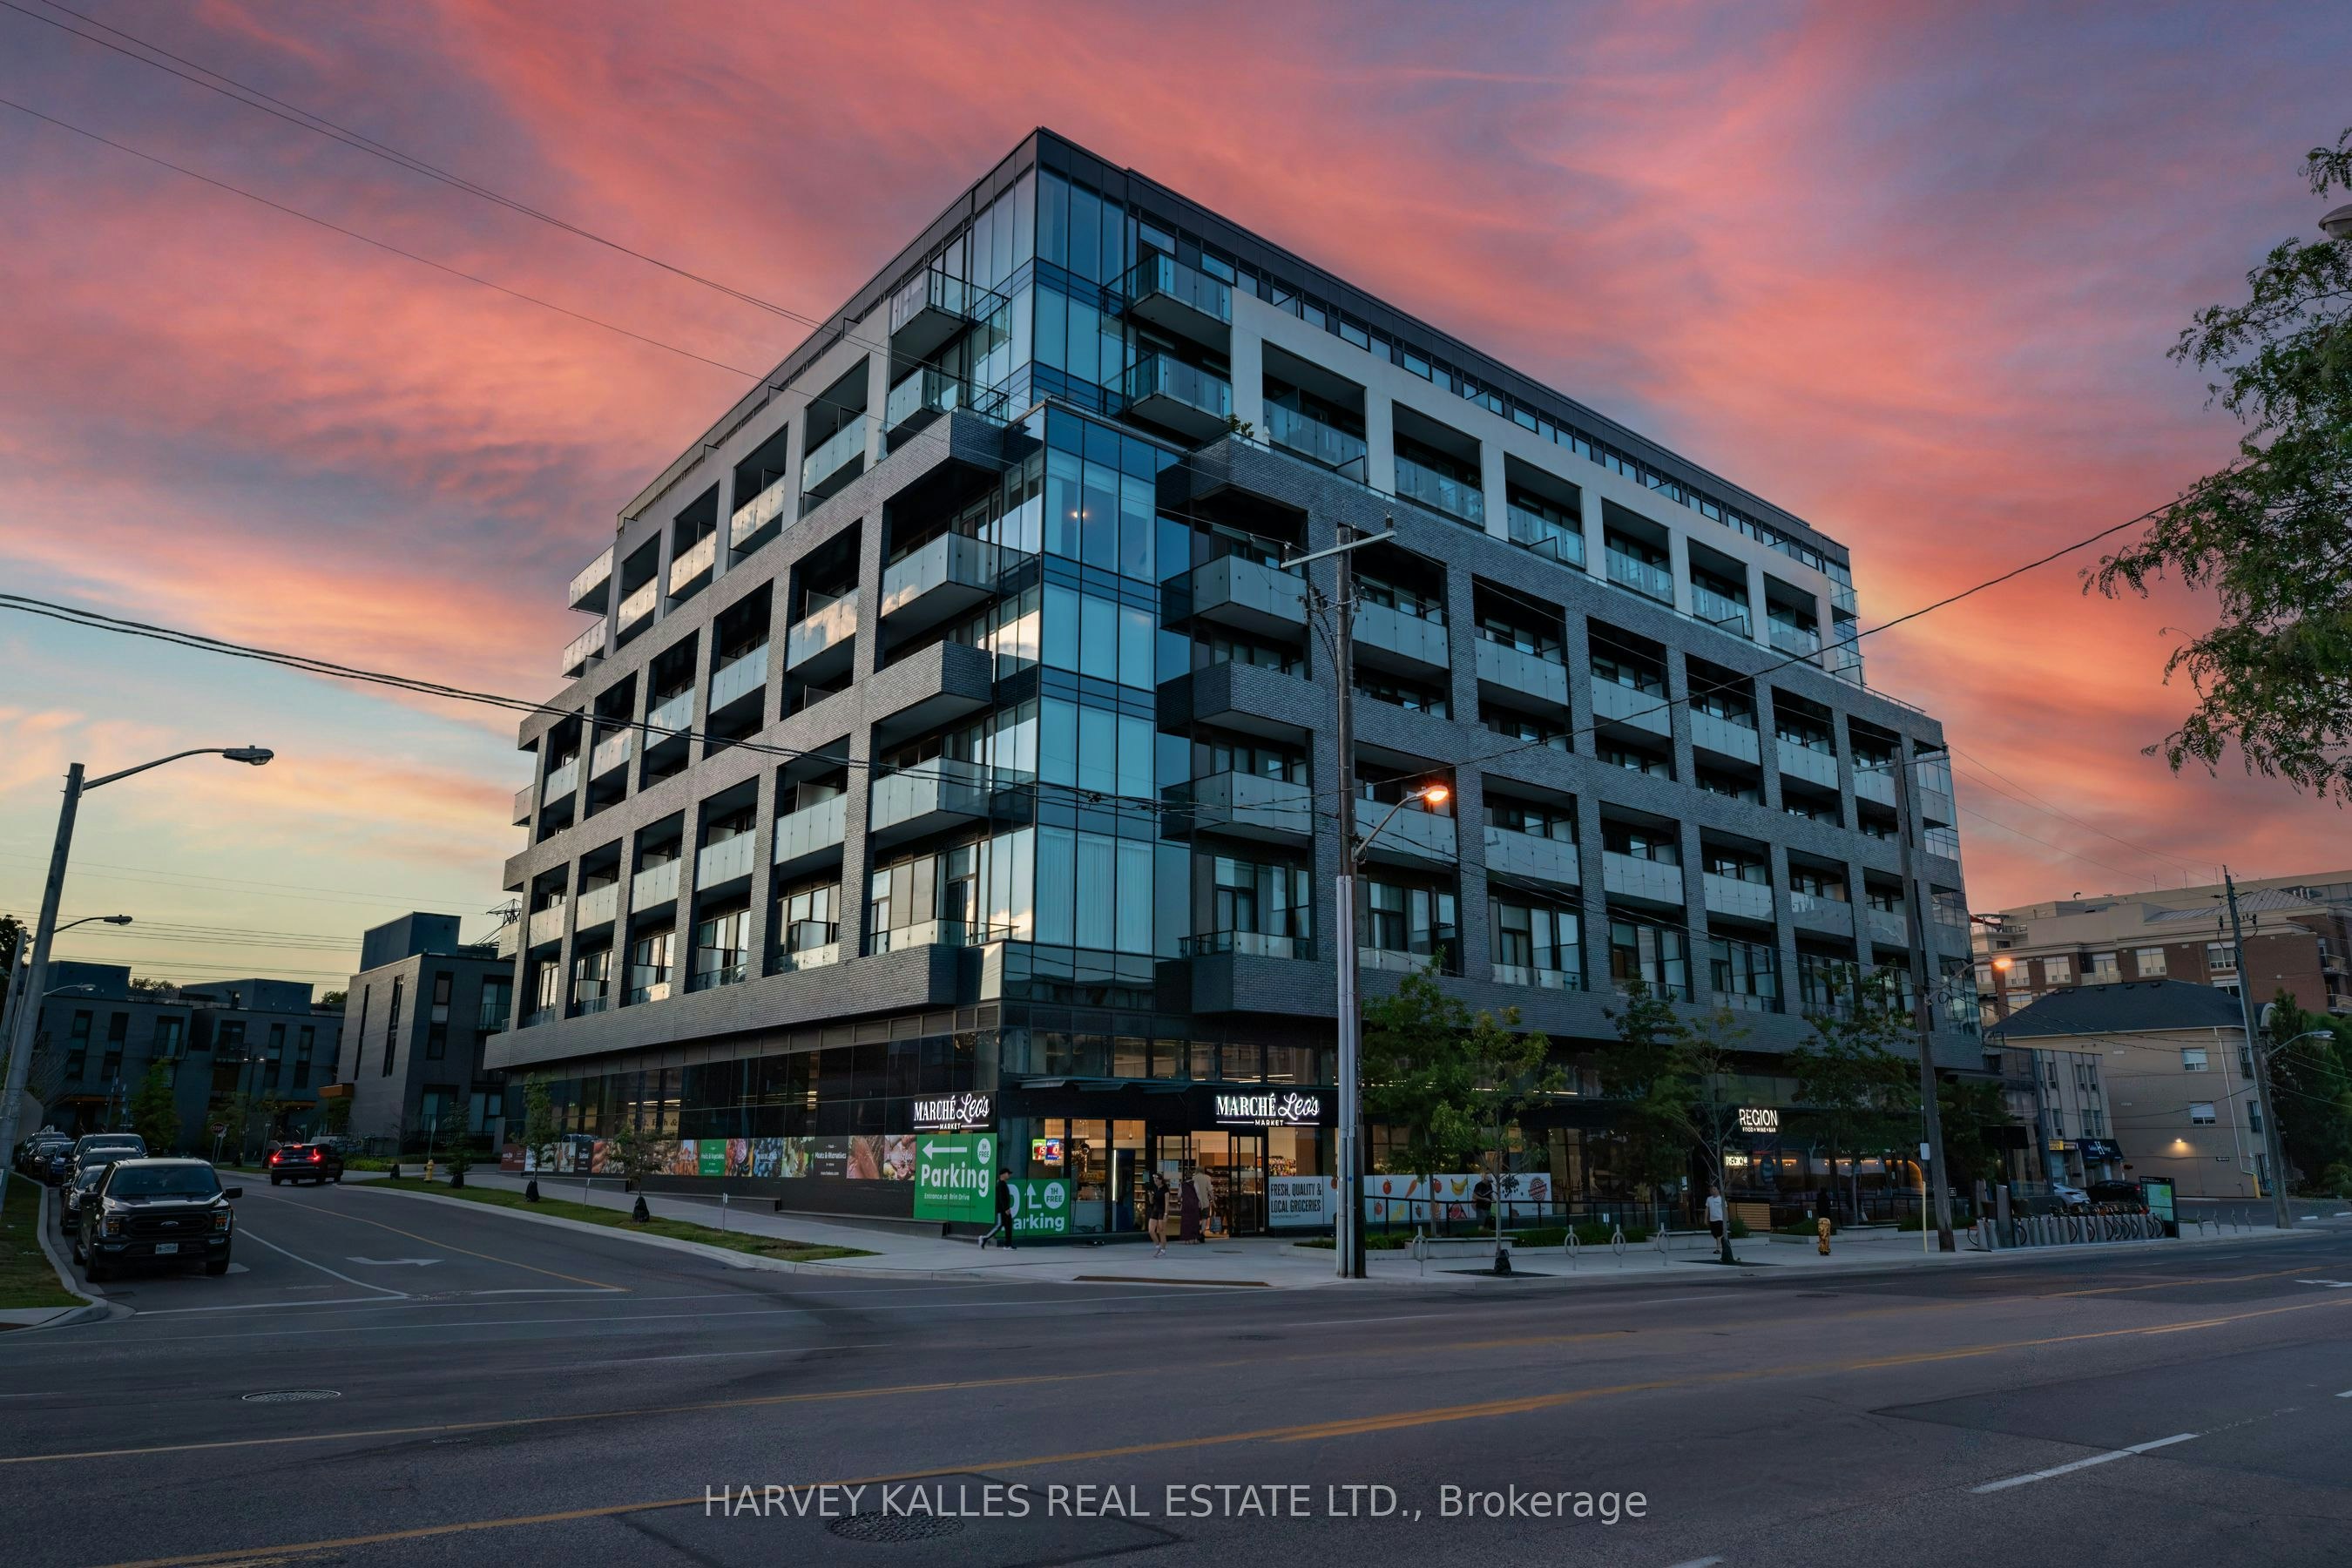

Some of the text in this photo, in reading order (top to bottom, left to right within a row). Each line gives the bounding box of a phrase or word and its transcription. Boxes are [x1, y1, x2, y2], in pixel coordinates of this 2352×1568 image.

[913, 1093, 990, 1123] MARCHÉ Leo's
[1216, 1092, 1321, 1121] MARCHÉ Leo's
[1739, 1108, 1779, 1126] REGION
[921, 1161, 990, 1198] Parking
[1270, 1183, 1322, 1197] FRESH, QUALITY &
[1270, 1199, 1321, 1213] LOCAL GROCERIES
[1013, 1213, 1064, 1232] arking
